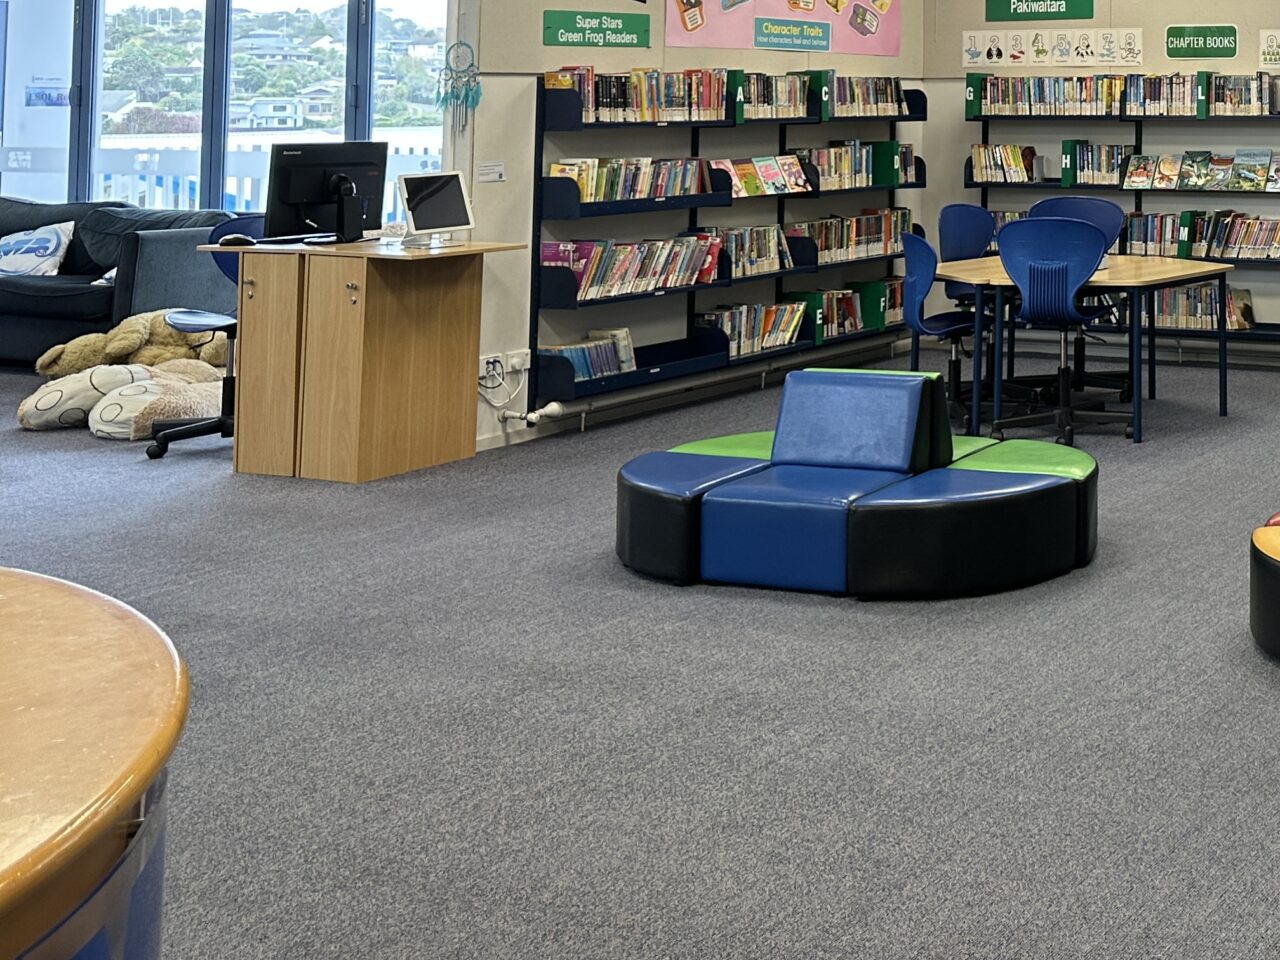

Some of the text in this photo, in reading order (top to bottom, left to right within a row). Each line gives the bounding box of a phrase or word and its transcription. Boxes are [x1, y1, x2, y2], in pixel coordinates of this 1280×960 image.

[576, 15, 623, 29] Super Stars
[762, 22, 823, 37] Character Traits
[558, 29, 638, 45] Green Frog Readers
[968, 35, 977, 51] 1
[989, 35, 1000, 51] 2
[1012, 34, 1022, 51] 3
[1032, 33, 1044, 49] 4
[1056, 33, 1067, 50] 5
[1079, 33, 1089, 50] 6
[1102, 33, 1112, 50] 7
[1125, 32, 1136, 50] 8
[1168, 36, 1235, 48] CHAPTER BOOKS
[1266, 34, 1278, 51] 9
[736, 87, 744, 101] A
[821, 86, 829, 101] C
[966, 87, 974, 101] G
[1198, 85, 1205, 100] L
[1062, 154, 1070, 168] H
[1179, 226, 1188, 242] M
[816, 309, 823, 324] E
